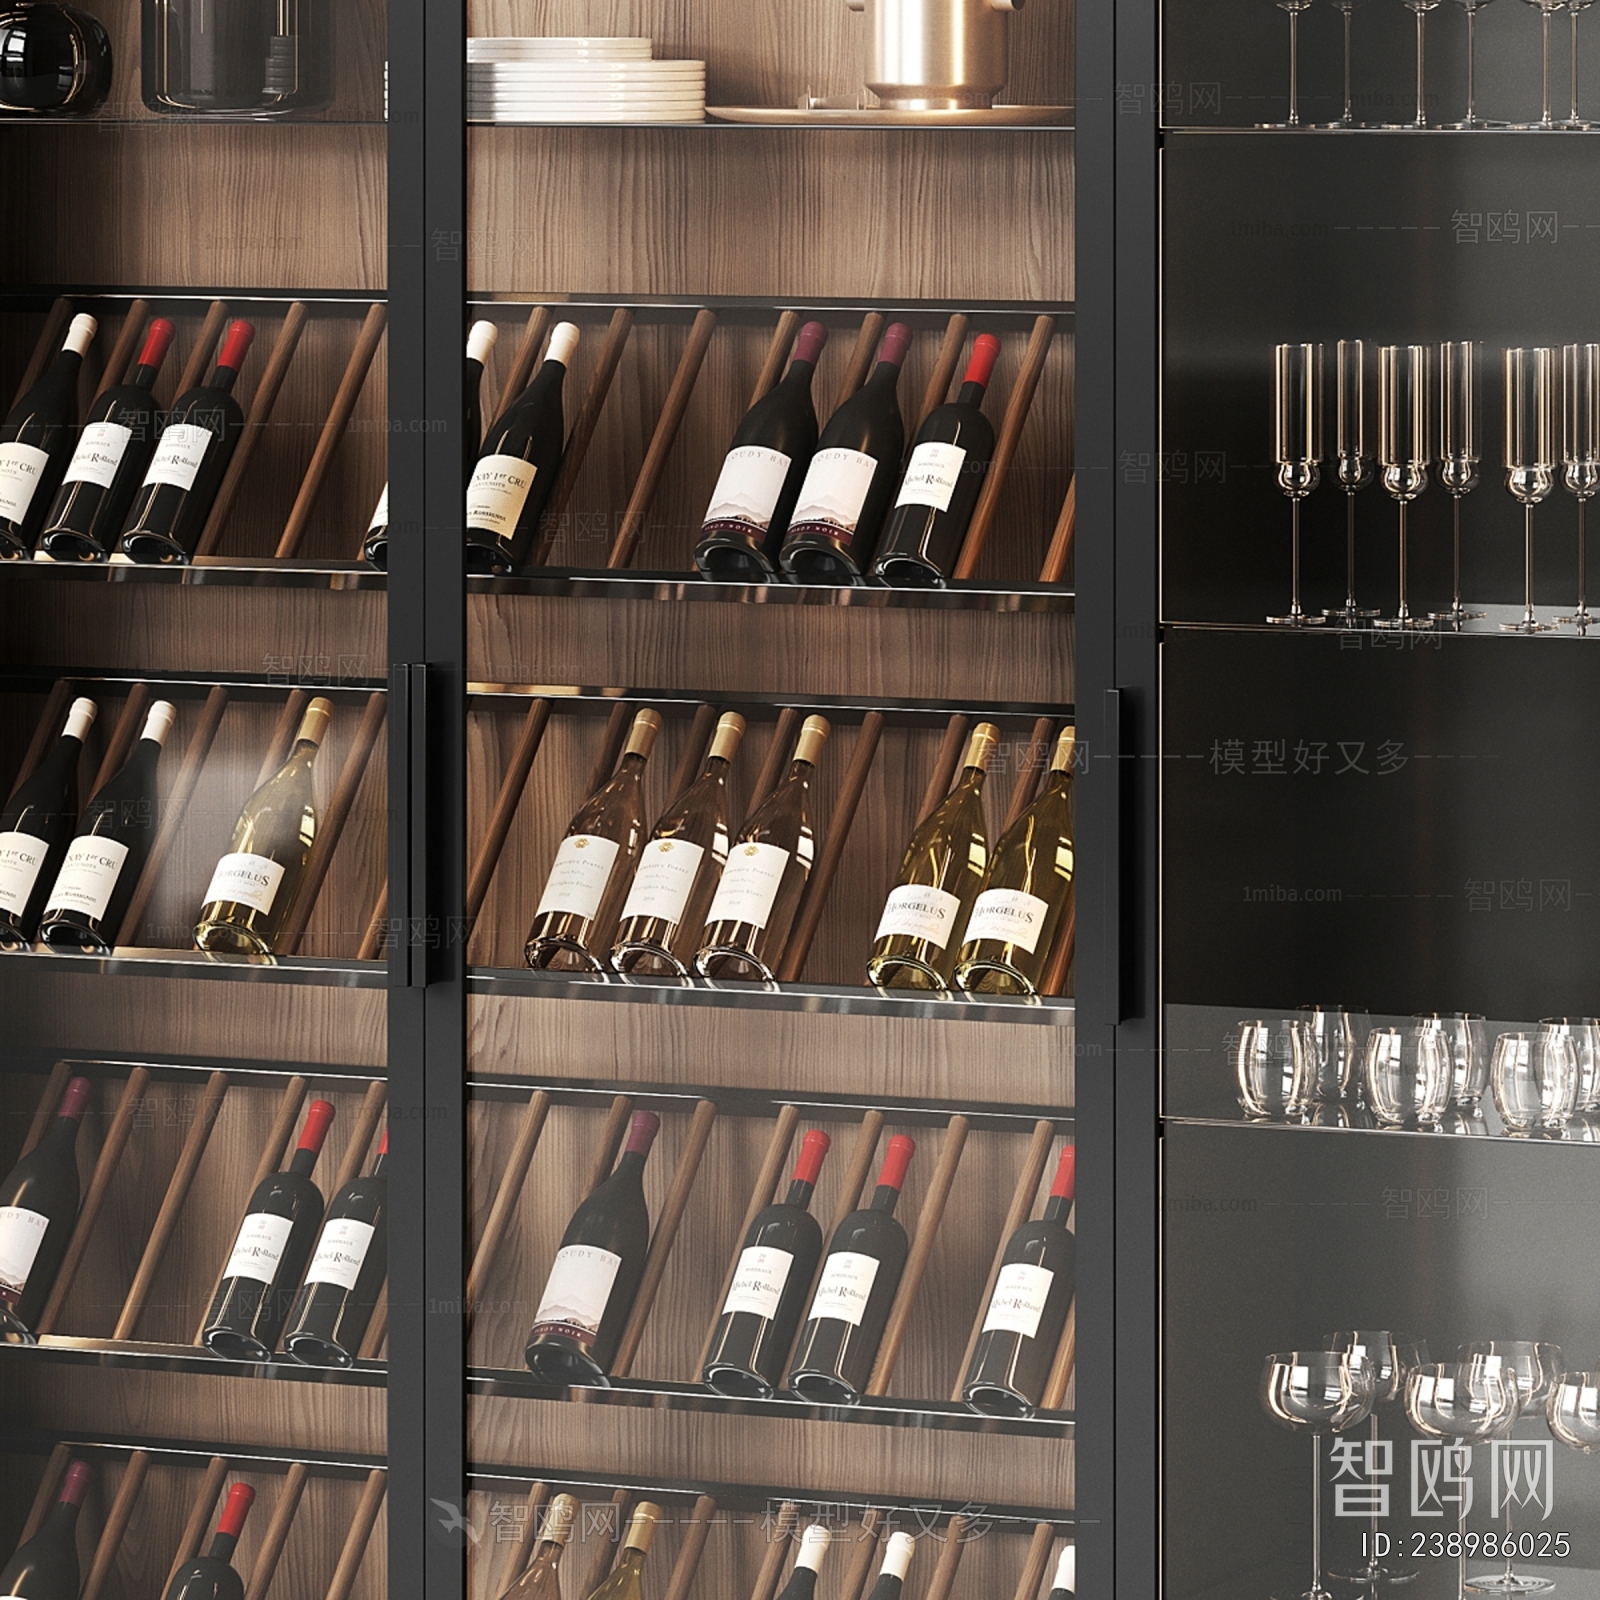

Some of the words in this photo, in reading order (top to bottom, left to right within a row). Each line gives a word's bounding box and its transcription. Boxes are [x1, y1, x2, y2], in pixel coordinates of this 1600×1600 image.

[20, 462, 38, 475] CRU
[508, 475, 527, 488] CRU
[20, 853, 38, 866] CRU
[99, 857, 119, 869] CRU
